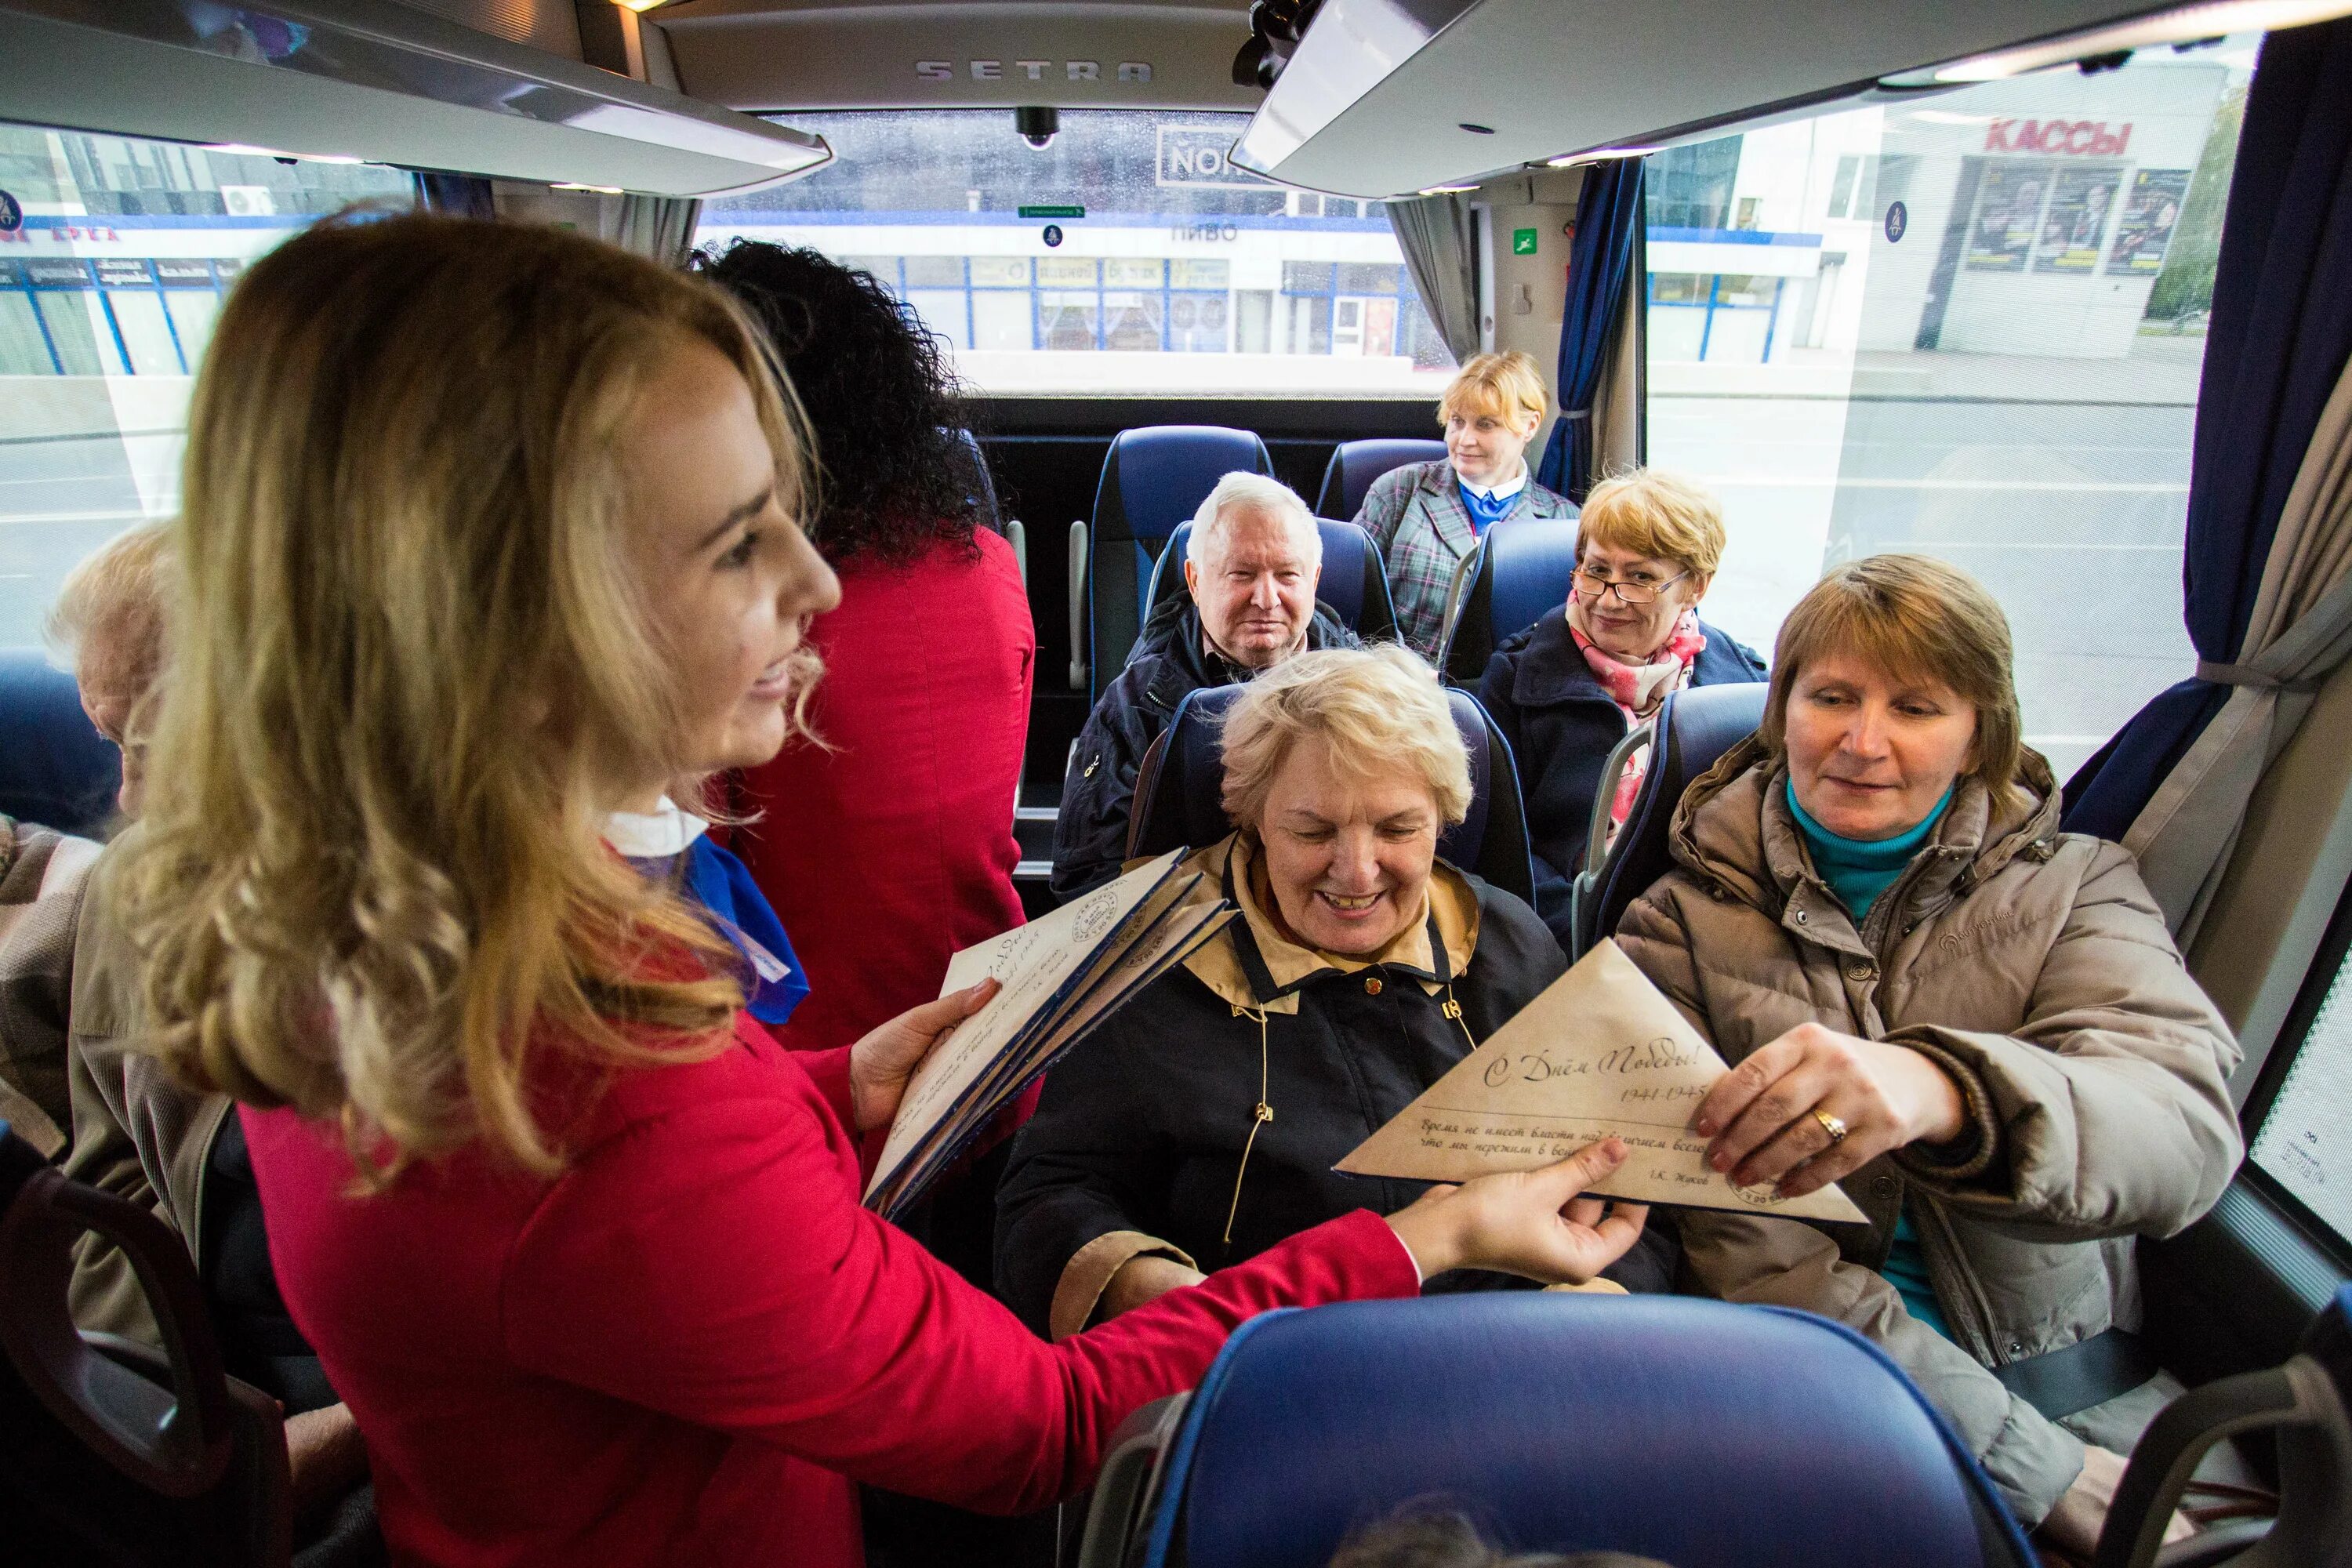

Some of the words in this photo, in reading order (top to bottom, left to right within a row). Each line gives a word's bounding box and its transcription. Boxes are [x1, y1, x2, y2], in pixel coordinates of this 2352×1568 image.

[916, 60, 1152, 81] SETRA
[1984, 118, 2132, 155] КАССЫ
[1483, 1058, 1512, 1087] С
[1521, 1050, 1588, 1081] Днём
[1598, 1037, 1700, 1075] Победы!
[1421, 1119, 1459, 1135] Время
[1465, 1127, 1479, 1135] не
[1485, 1127, 1525, 1138] имеет
[1530, 1127, 1574, 1140] власти
[1581, 1131, 1602, 1142] над
[1421, 1138, 1443, 1148] что
[1449, 1142, 1468, 1151] мы
[1475, 1142, 1531, 1157] пережили
[1537, 1143, 1547, 1155] в
